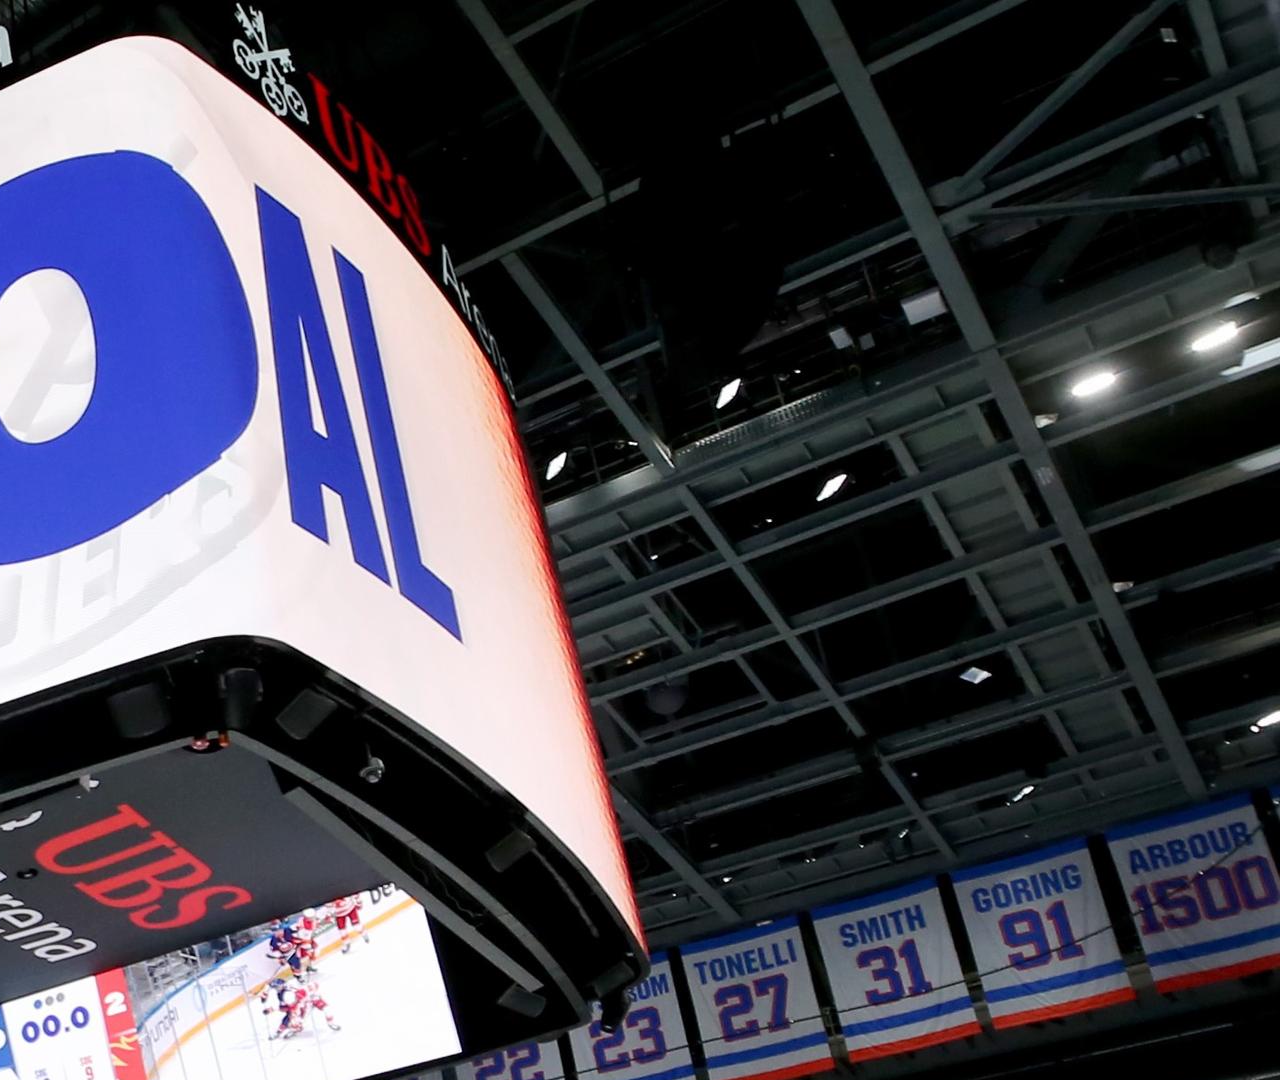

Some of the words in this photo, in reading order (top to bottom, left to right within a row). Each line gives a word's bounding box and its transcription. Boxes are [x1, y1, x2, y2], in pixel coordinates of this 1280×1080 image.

[308, 72, 430, 257] UBS
[35, 804, 252, 930] UBS
[1130, 821, 1254, 874] ARBOUR
[971, 863, 1083, 914] GORING
[1130, 855, 1280, 937] 1500
[840, 904, 927, 948] SMITH
[998, 900, 1085, 971] 91
[694, 939, 798, 985] TONELLI
[856, 938, 932, 1006] 31
[22, 1006, 90, 1043] 00.0
[104, 991, 128, 1017] 2
[713, 972, 790, 1043] 27
[589, 1006, 667, 1074] 23
